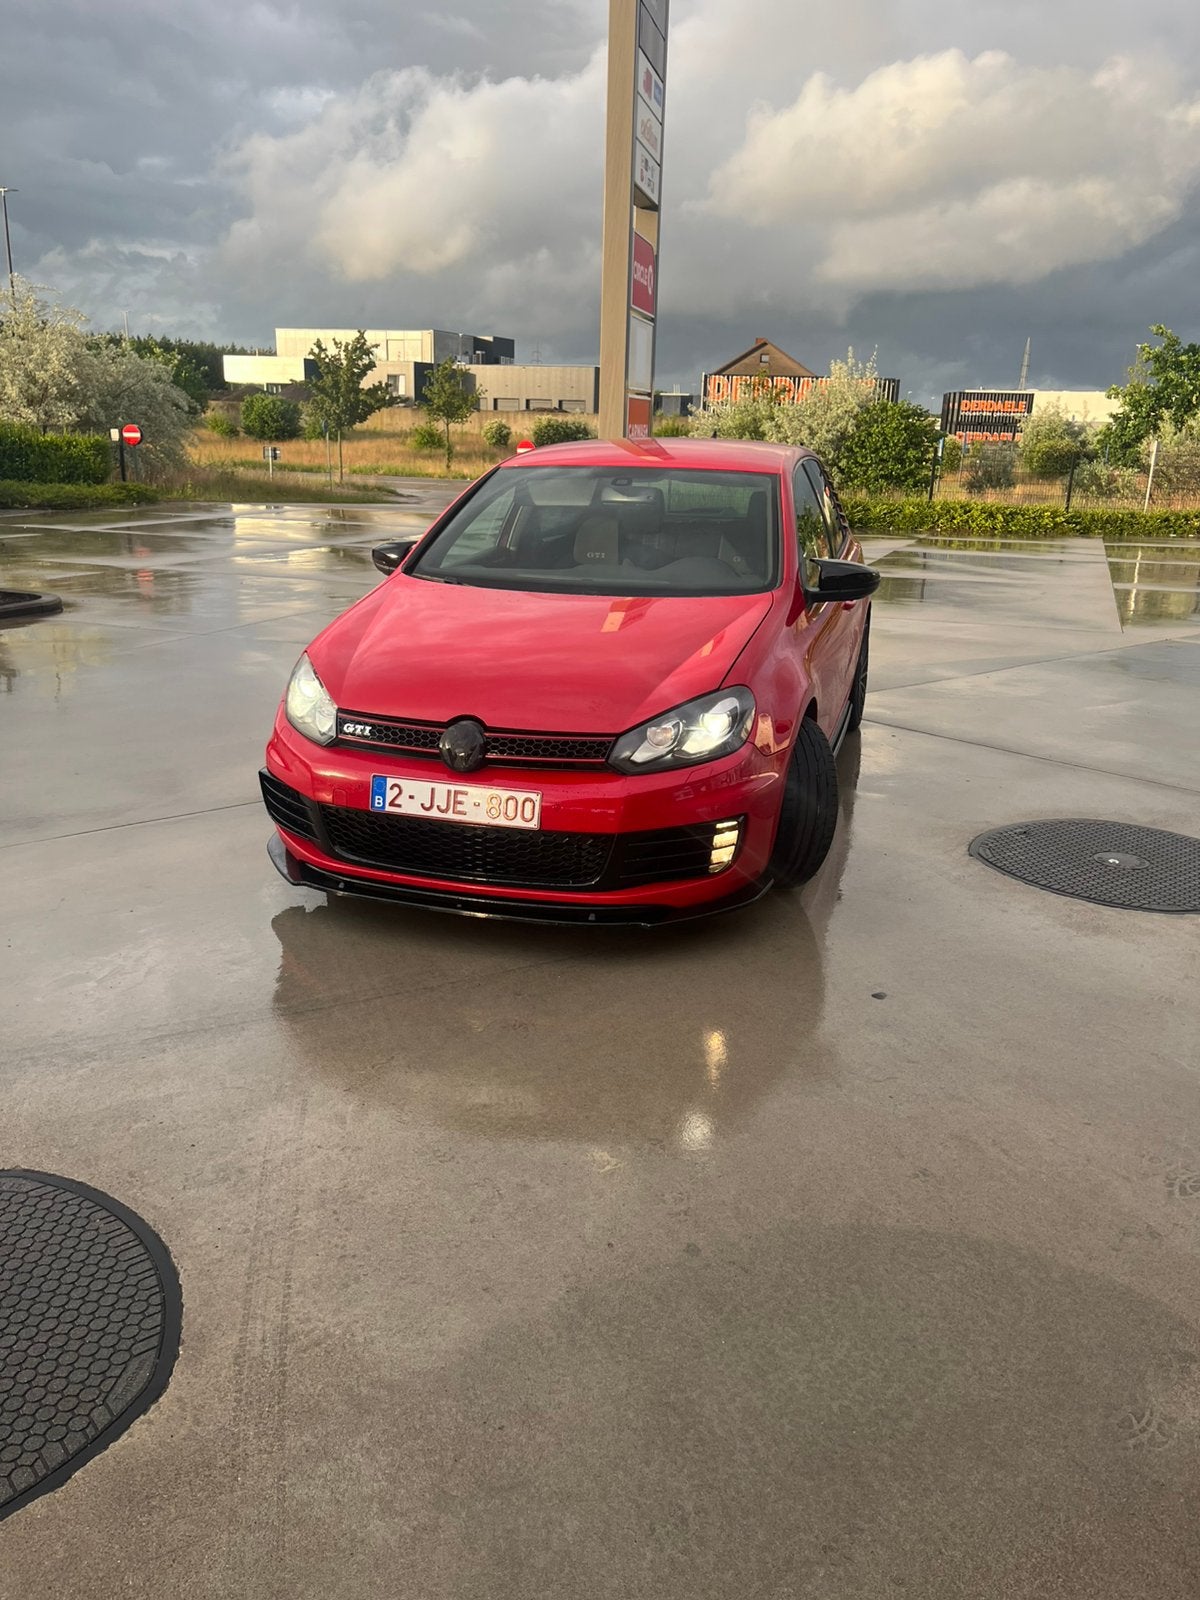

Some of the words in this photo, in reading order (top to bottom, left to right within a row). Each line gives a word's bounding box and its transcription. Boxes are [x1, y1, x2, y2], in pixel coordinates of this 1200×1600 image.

[586, 551, 606, 559] GTI
[343, 722, 372, 737] GTI
[374, 795, 384, 808] B
[388, 783, 536, 823] 2-JJE-800
